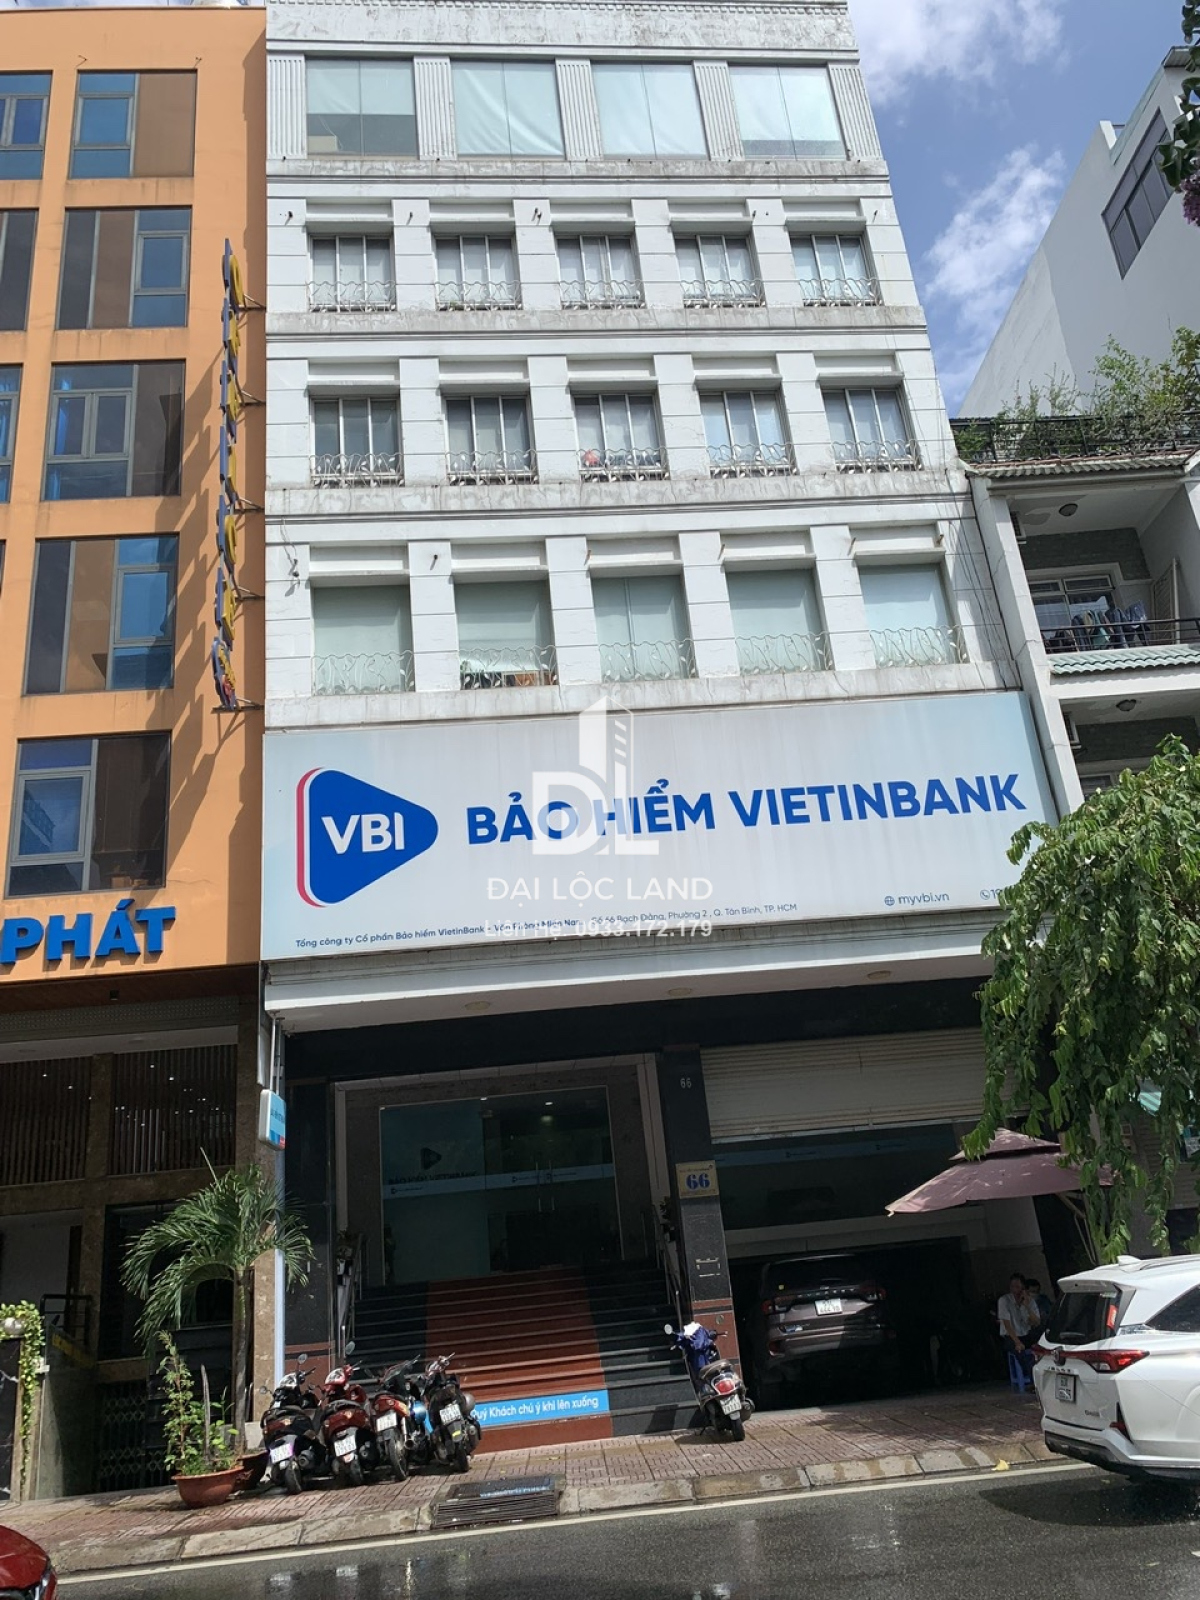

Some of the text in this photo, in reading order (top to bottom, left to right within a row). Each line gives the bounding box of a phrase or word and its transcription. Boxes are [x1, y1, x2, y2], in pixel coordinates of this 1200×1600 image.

[466, 773, 1028, 846] BẢO HIỂM VIETINBANK
[320, 811, 406, 855] VBI
[898, 892, 950, 906] myvbi.vn
[0, 898, 176, 965] PHÁT
[319, 937, 343, 947] công
[344, 935, 354, 946] ty
[395, 930, 414, 940] Bảo
[438, 924, 485, 937] VietinBank
[713, 909, 723, 917] Q.
[764, 904, 776, 913] TP.
[777, 903, 798, 912] HCM
[680, 1077, 692, 1089] 66
[685, 1172, 711, 1190] 66
[489, 1405, 517, 1418] Khách
[518, 1402, 534, 1415] chú
[536, 1403, 541, 1415] ý
[542, 1399, 556, 1412] khi
[557, 1398, 571, 1411] lên
[572, 1395, 600, 1409] xuống
